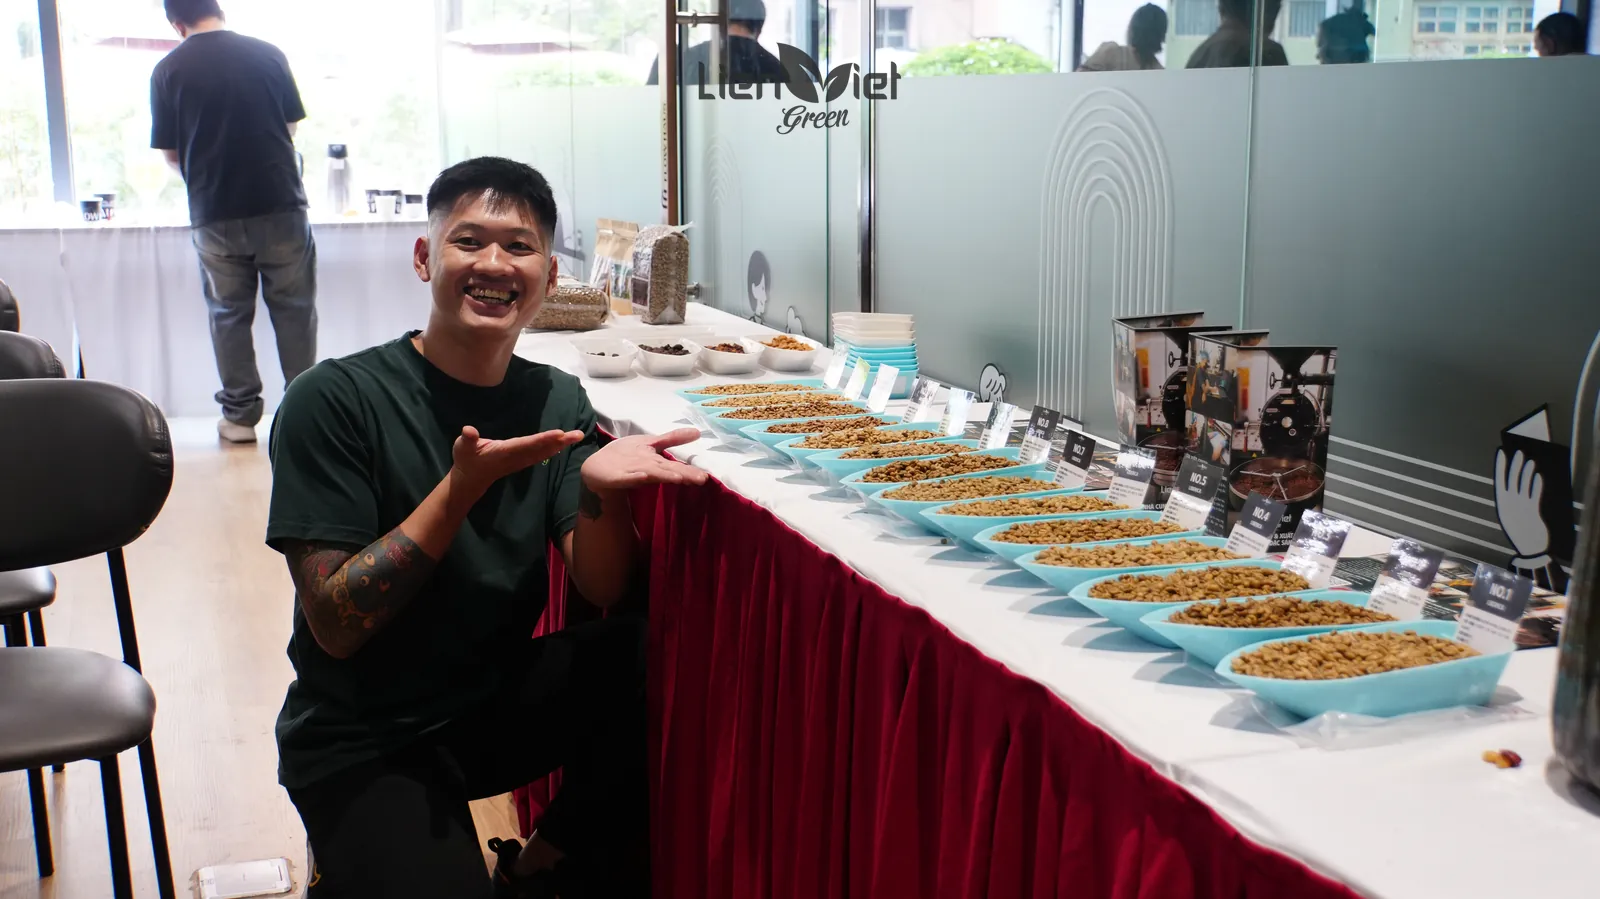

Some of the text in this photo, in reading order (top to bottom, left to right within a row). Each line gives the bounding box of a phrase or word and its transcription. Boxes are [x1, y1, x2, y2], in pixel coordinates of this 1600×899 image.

[1190, 472, 1208, 486] NO.5
[1252, 506, 1271, 521] NO.4
[1489, 582, 1513, 601] NO.1
